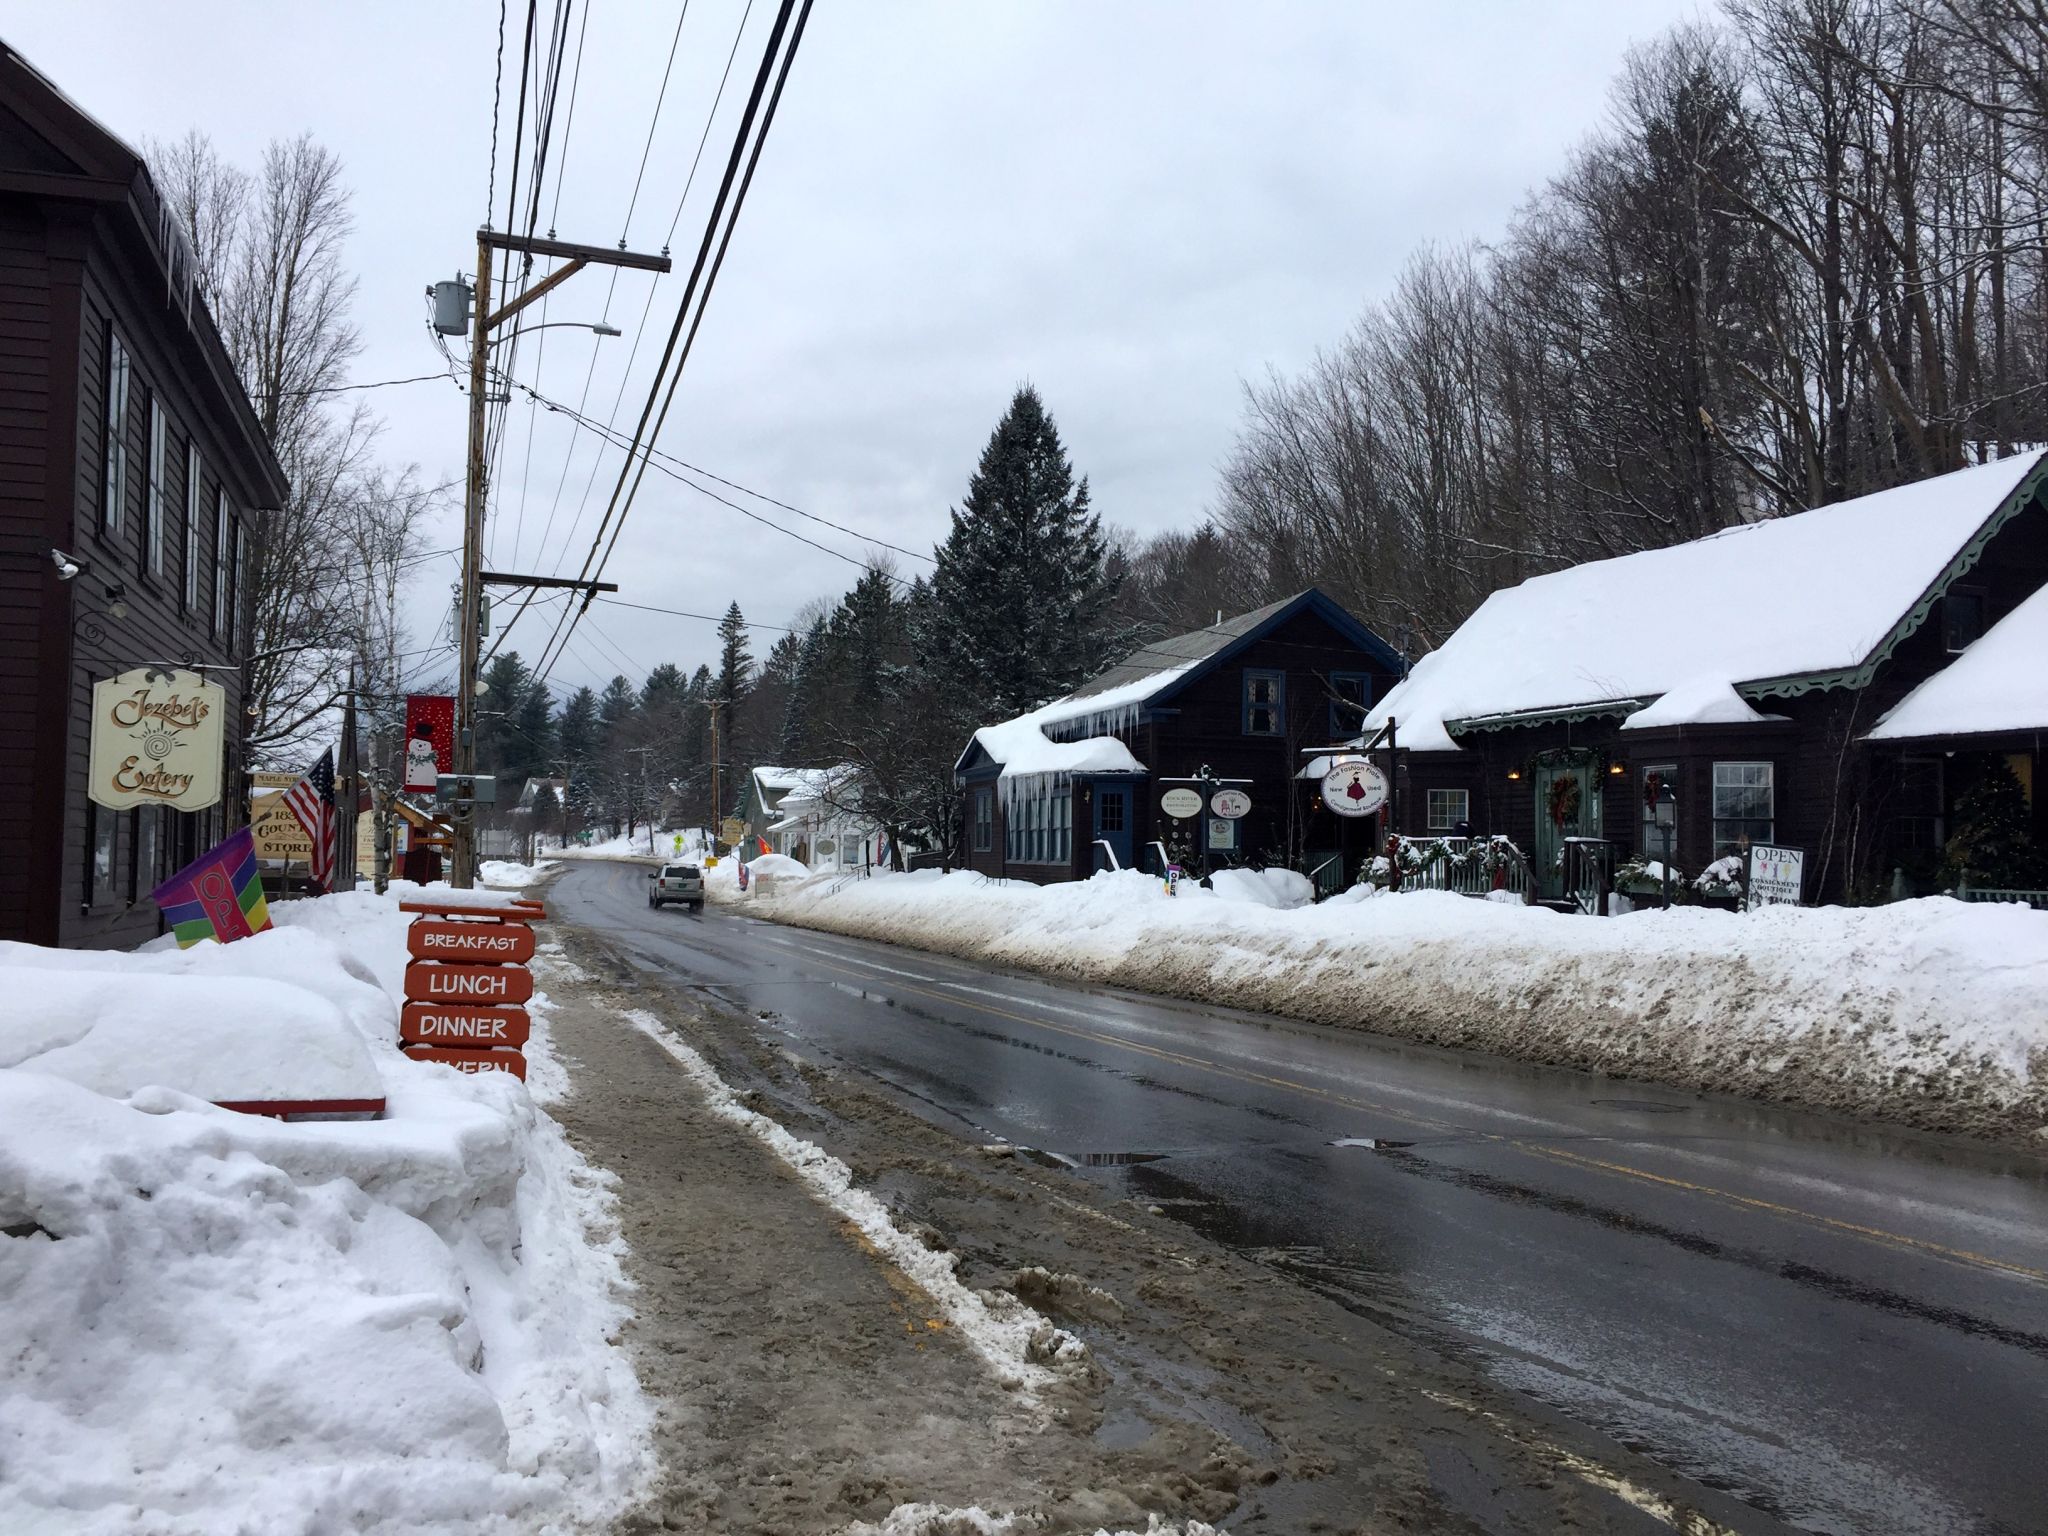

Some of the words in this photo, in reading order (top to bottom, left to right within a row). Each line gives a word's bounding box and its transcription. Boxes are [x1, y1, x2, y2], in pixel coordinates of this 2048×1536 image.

[111, 690, 210, 730] Jezebel's
[112, 755, 194, 799] Eatery
[1340, 765, 1364, 773] Fashion
[1366, 768, 1380, 779] Plate
[264, 842, 312, 853] STORE
[1755, 848, 1800, 864] OPEN
[1751, 878, 1800, 888] CONSIGNMENT
[1757, 884, 1792, 893] BOUTIQUE
[424, 934, 518, 950] BREAKFAST
[429, 974, 507, 995] LUNCH
[419, 1015, 508, 1039] DINNER
